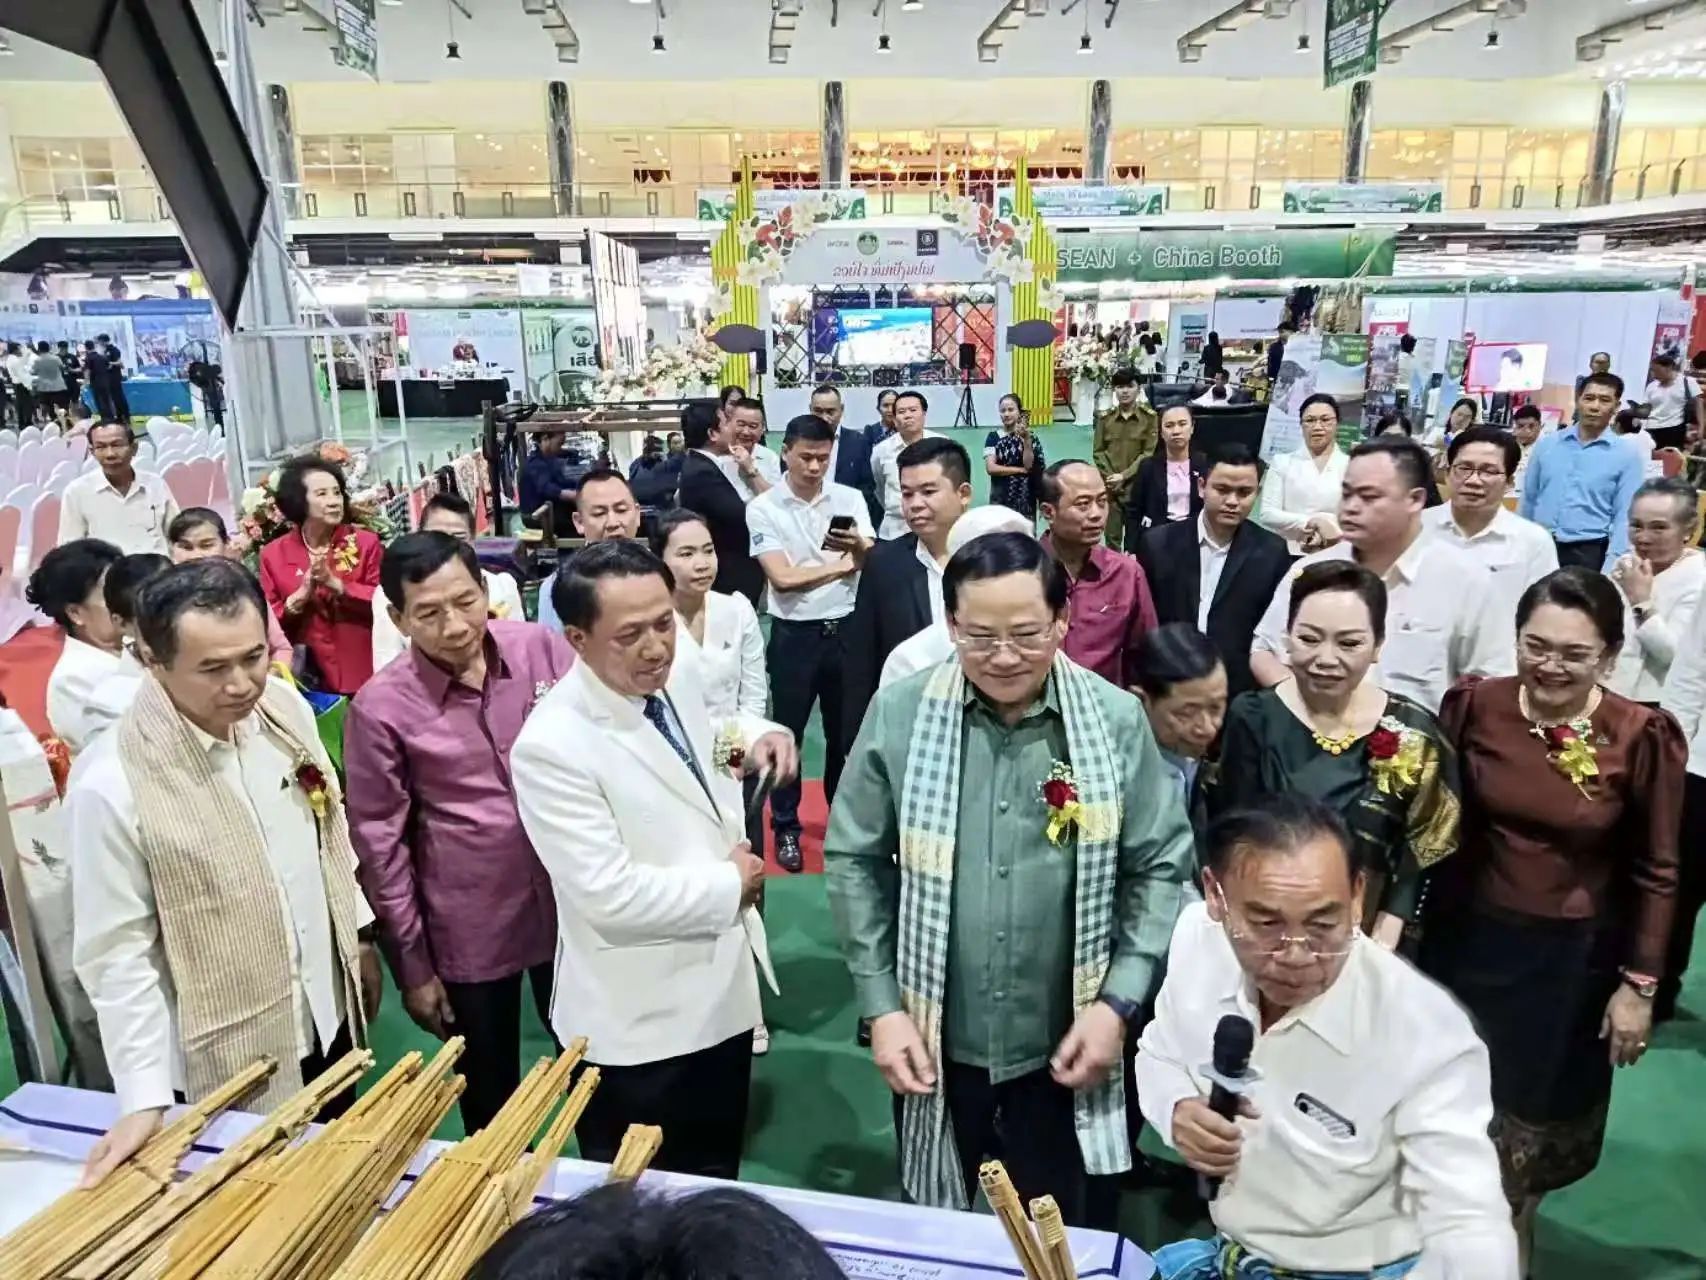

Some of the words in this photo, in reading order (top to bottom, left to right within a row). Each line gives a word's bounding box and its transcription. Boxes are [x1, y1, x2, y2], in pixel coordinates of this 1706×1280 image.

[1056, 247, 1116, 269] SEAN
[1152, 246, 1213, 268] China
[1219, 244, 1282, 266] Booth
